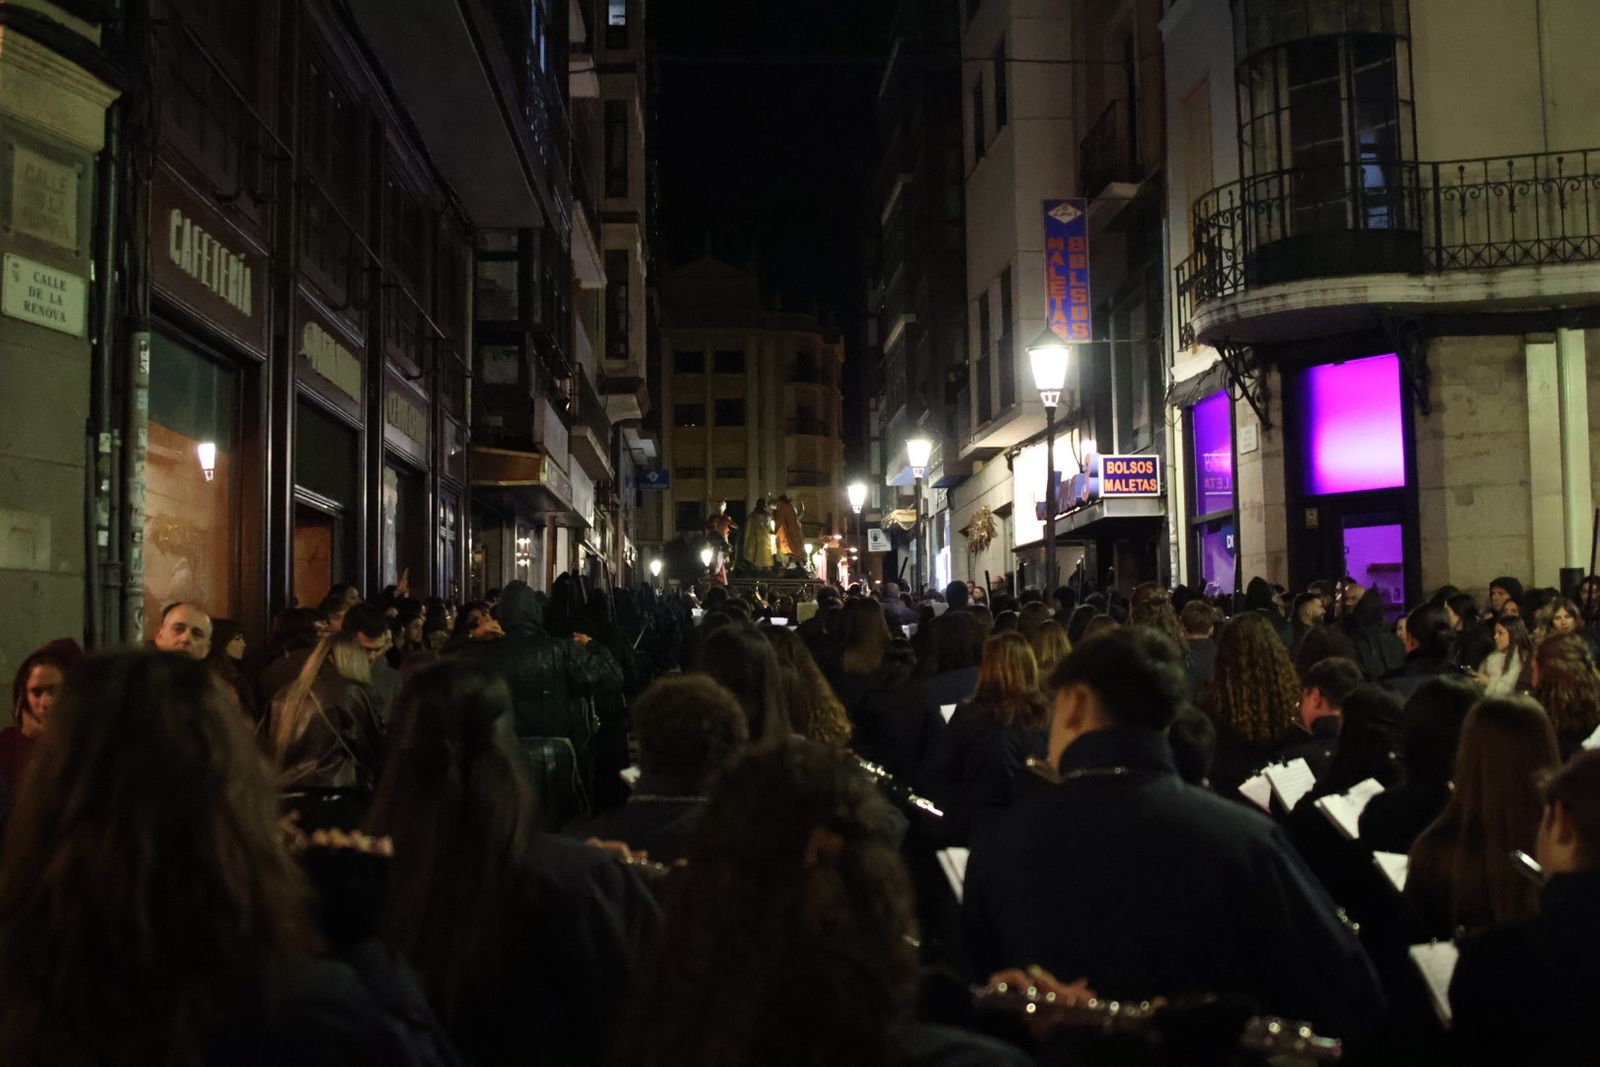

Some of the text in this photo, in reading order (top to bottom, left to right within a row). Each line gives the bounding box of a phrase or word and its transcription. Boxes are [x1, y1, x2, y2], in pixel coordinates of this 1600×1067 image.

[170, 208, 252, 317] CAFETERÍA
[33, 271, 66, 291] CALLE
[28, 286, 63, 306] DE LA
[24, 300, 66, 322] RENOVA
[1106, 461, 1153, 474] BOLSOS
[1104, 478, 1157, 492] MALETAS
